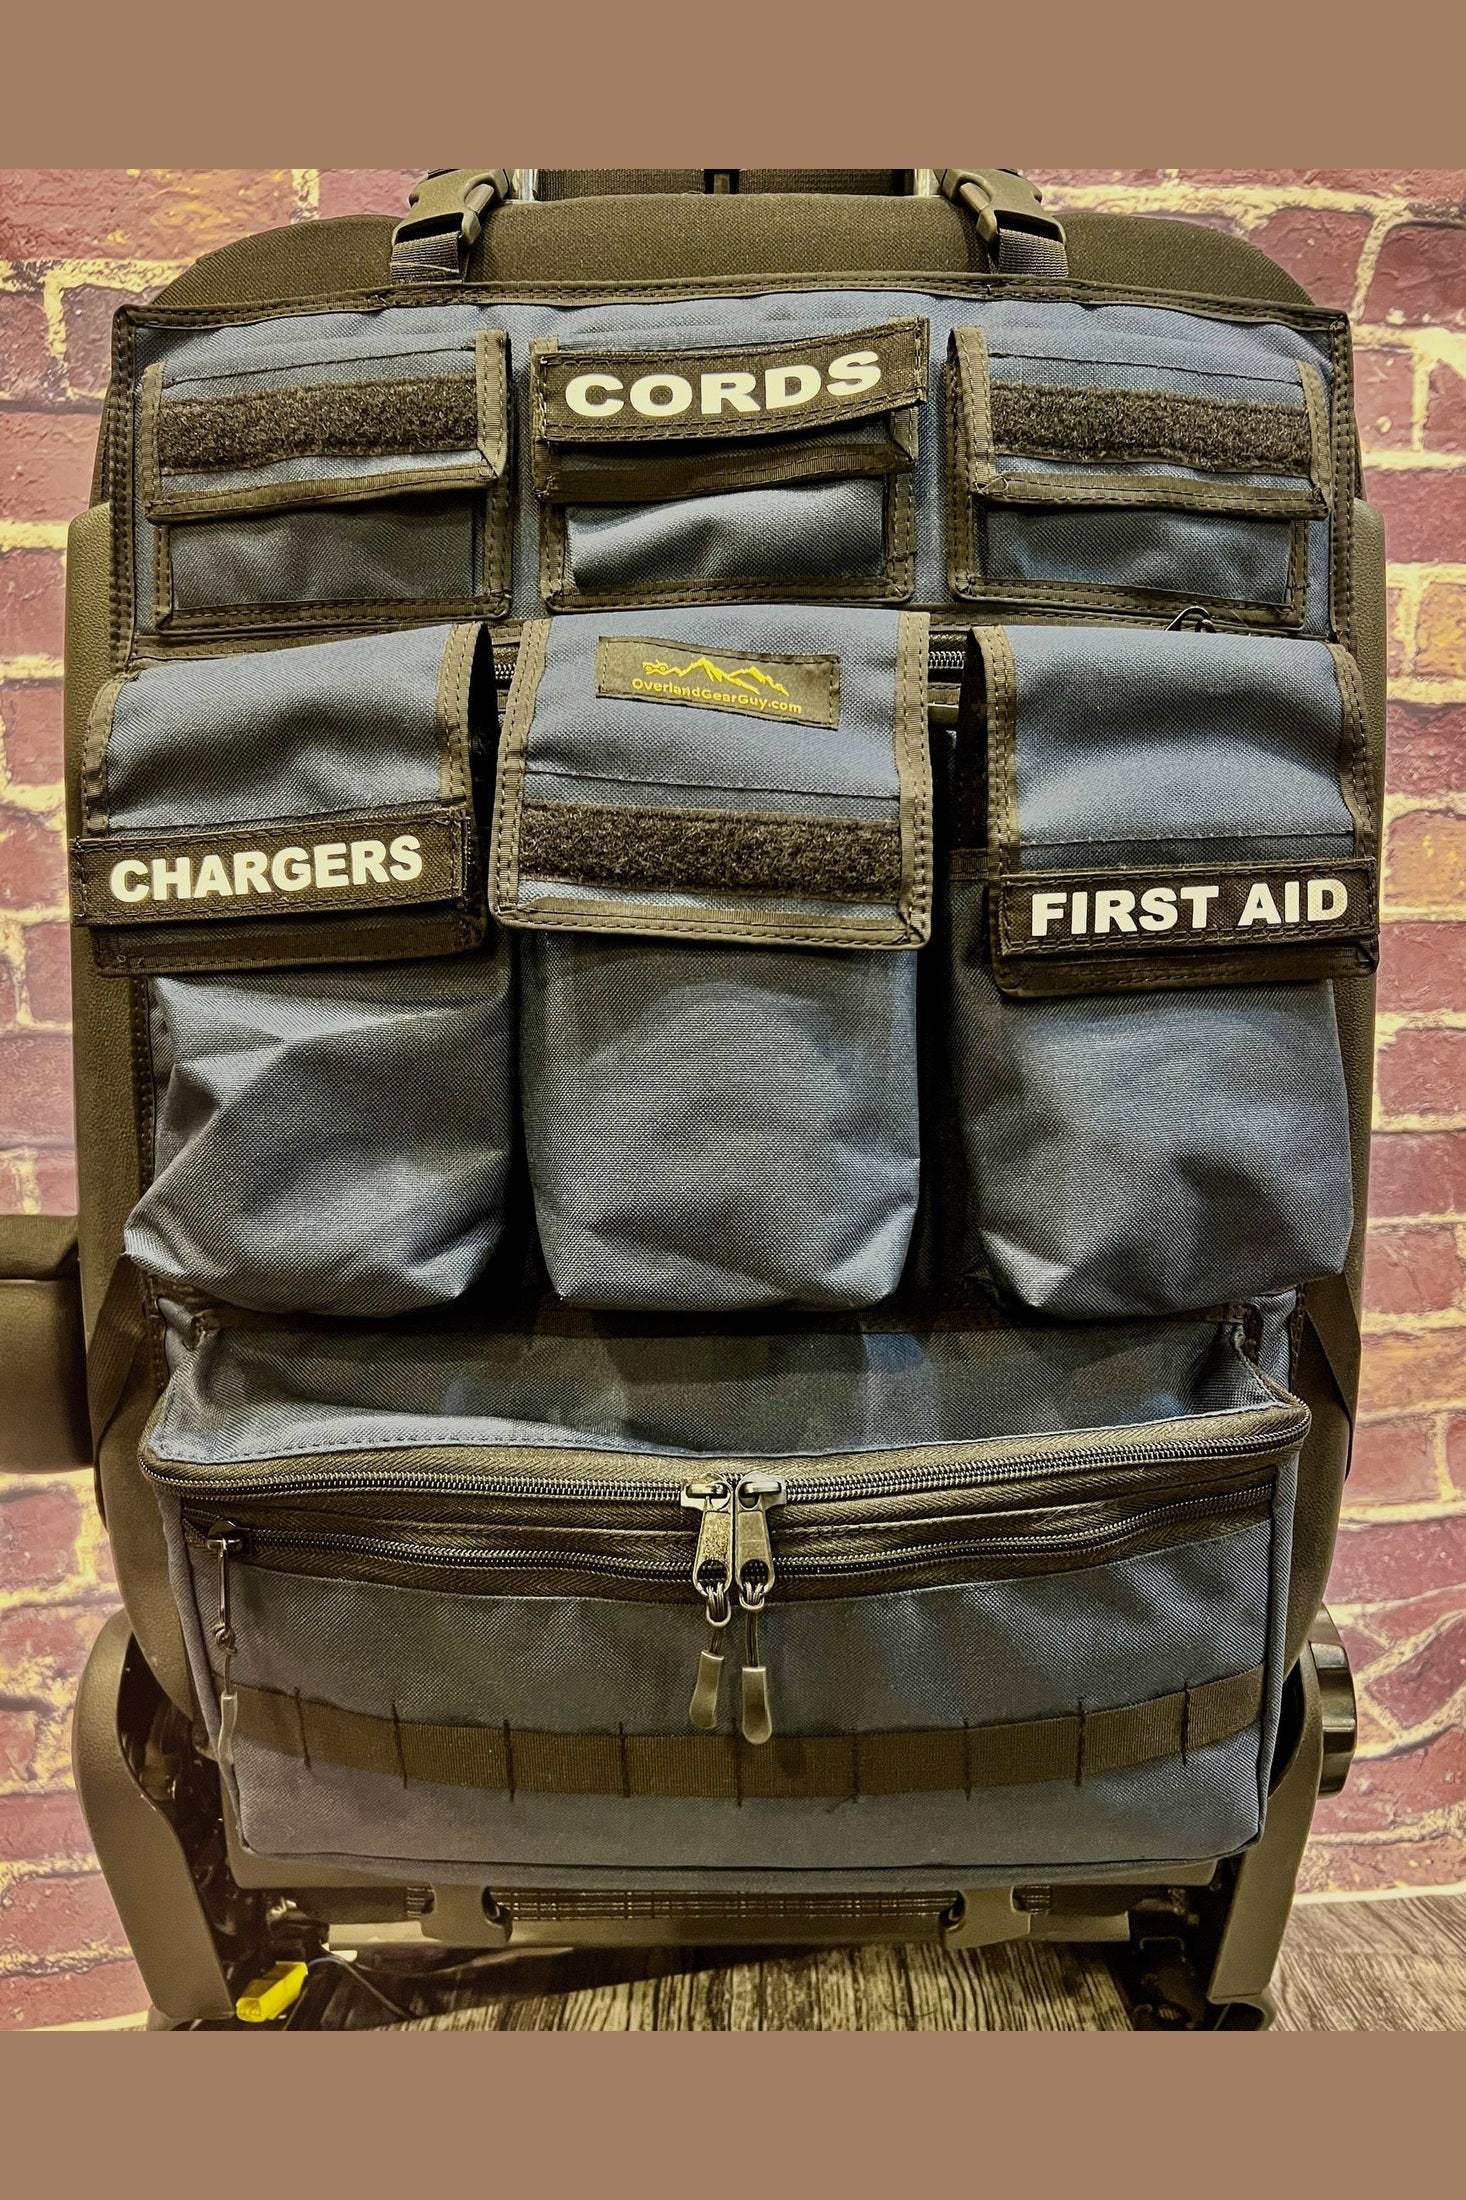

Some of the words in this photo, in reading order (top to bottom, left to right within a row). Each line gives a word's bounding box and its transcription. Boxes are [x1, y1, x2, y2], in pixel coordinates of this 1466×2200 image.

[565, 350, 882, 417] CORDS
[631, 678, 803, 714] OverlandGearGuy.com
[110, 835, 424, 903] CHARGERS
[1031, 885, 1220, 937] FIRST
[1238, 879, 1348, 927] AID
